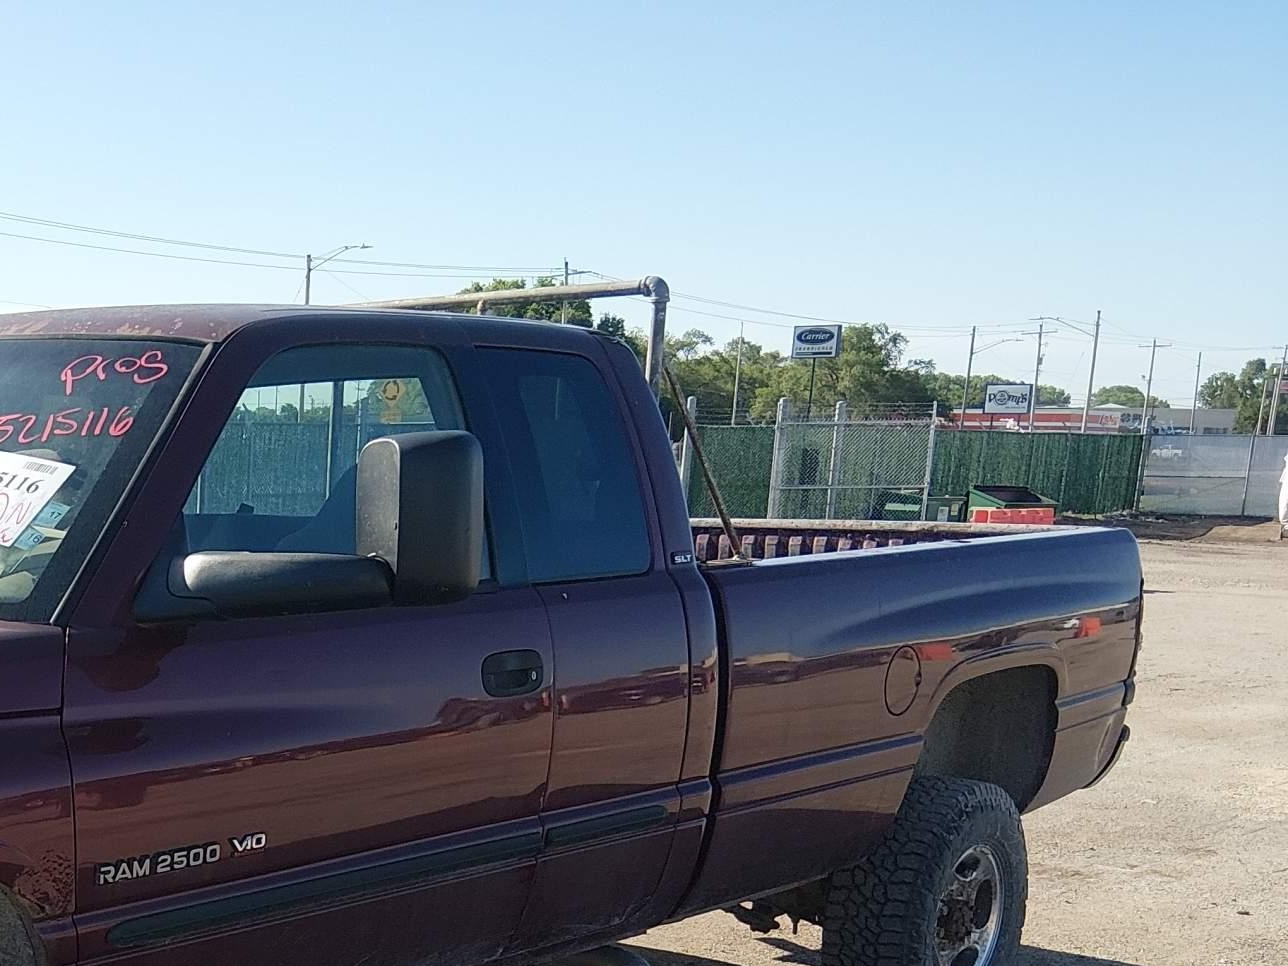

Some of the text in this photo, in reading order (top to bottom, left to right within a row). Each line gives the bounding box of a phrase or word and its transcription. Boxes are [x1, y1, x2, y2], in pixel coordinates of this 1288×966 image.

[801, 331, 831, 341] Carrier
[48, 511, 62, 520] 17
[29, 532, 43, 543] 16
[674, 554, 692, 563] SLT
[99, 833, 267, 885] RAM 2500 V10
